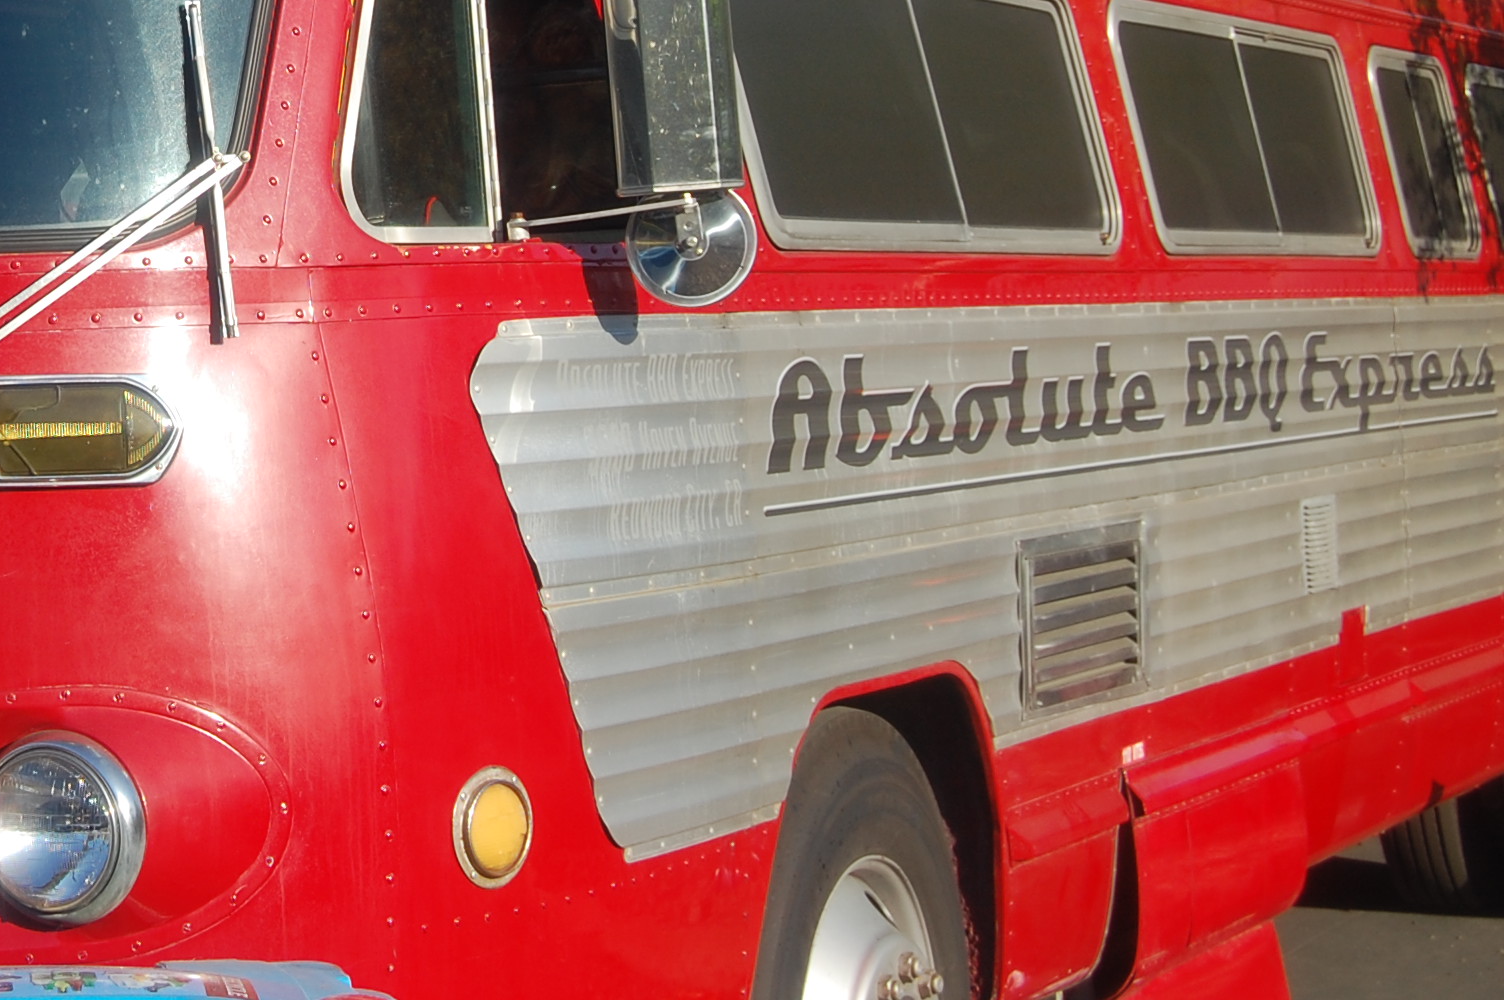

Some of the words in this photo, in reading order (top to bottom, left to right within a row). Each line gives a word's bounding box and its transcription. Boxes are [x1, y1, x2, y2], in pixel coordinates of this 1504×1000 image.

[767, 342, 1166, 475] Absolute
[1183, 331, 1289, 432] BBQ
[1298, 330, 1497, 431] Express
